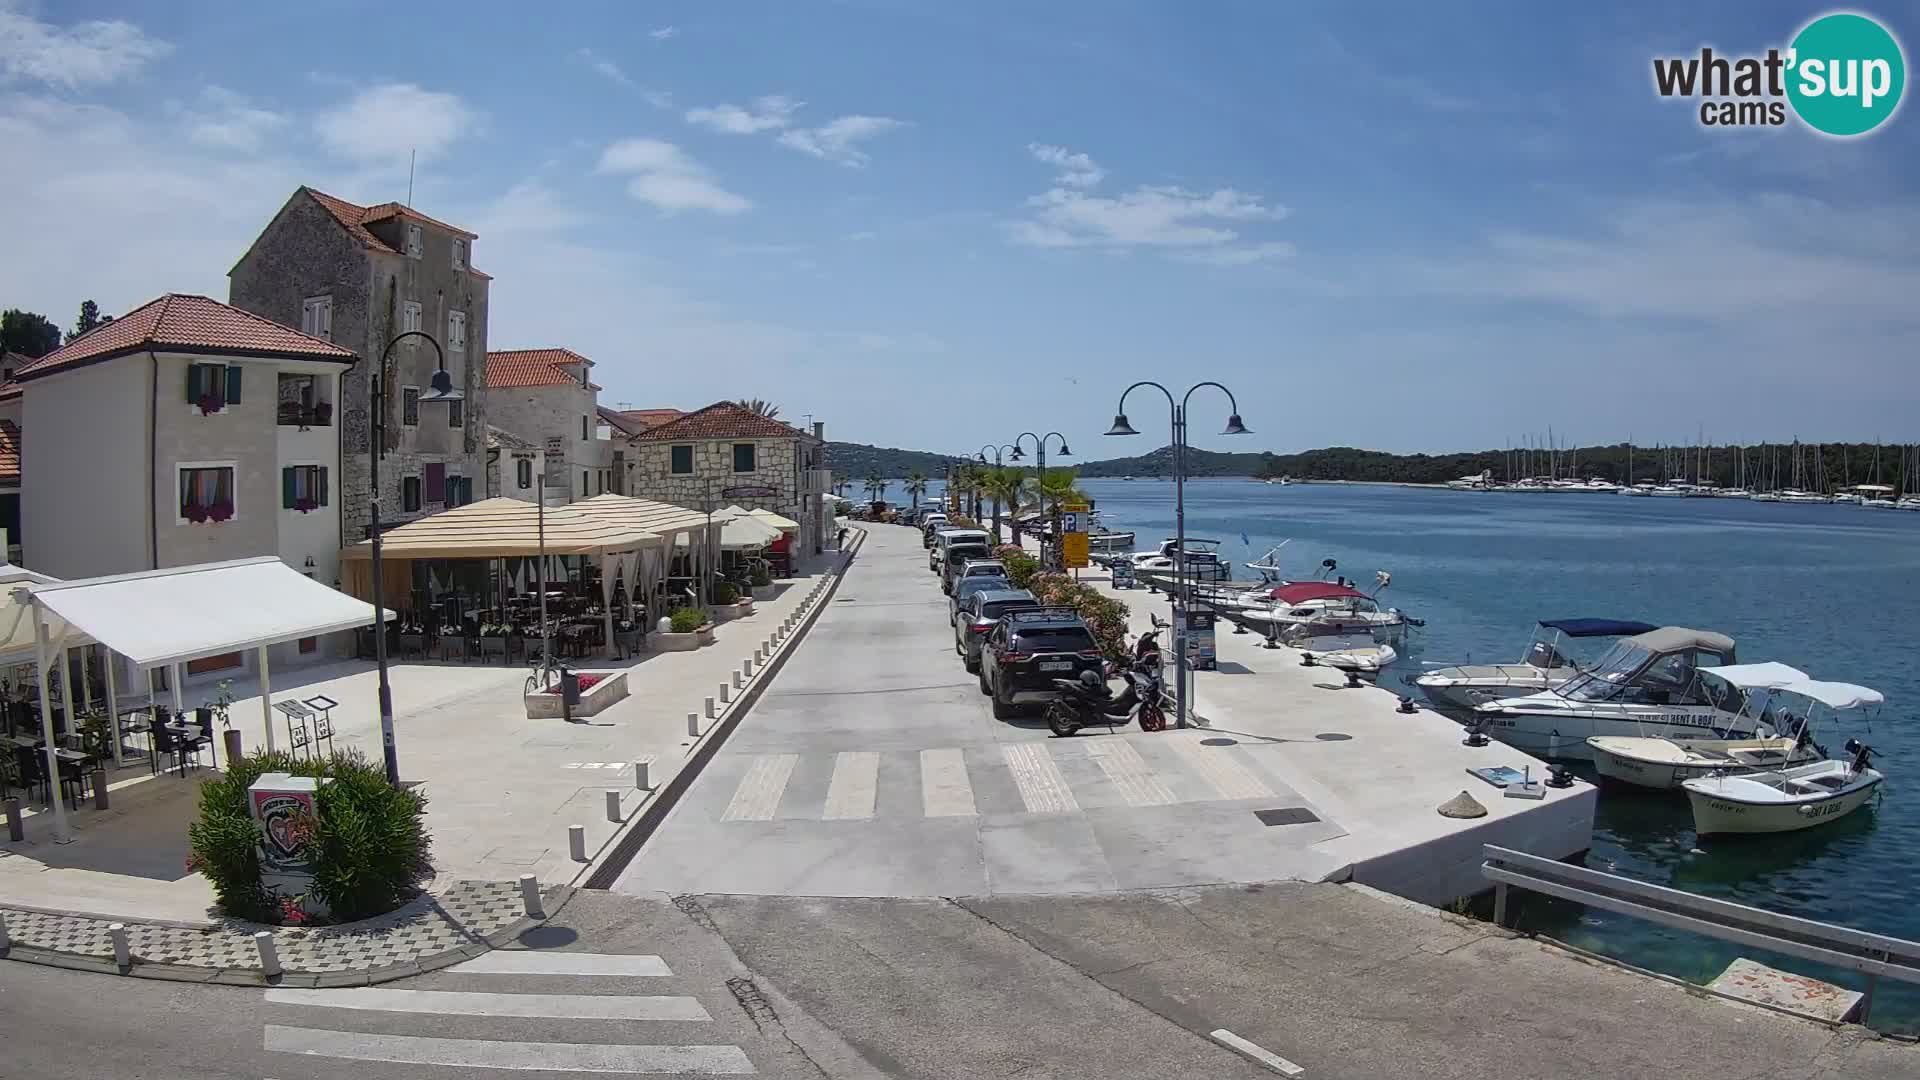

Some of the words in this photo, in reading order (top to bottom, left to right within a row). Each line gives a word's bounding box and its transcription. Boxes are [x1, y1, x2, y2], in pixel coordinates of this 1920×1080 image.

[1065, 514, 1076, 531] P
[1670, 713, 1691, 725] RENT
[1691, 714, 1697, 725] A
[1697, 714, 1717, 727] BOAT
